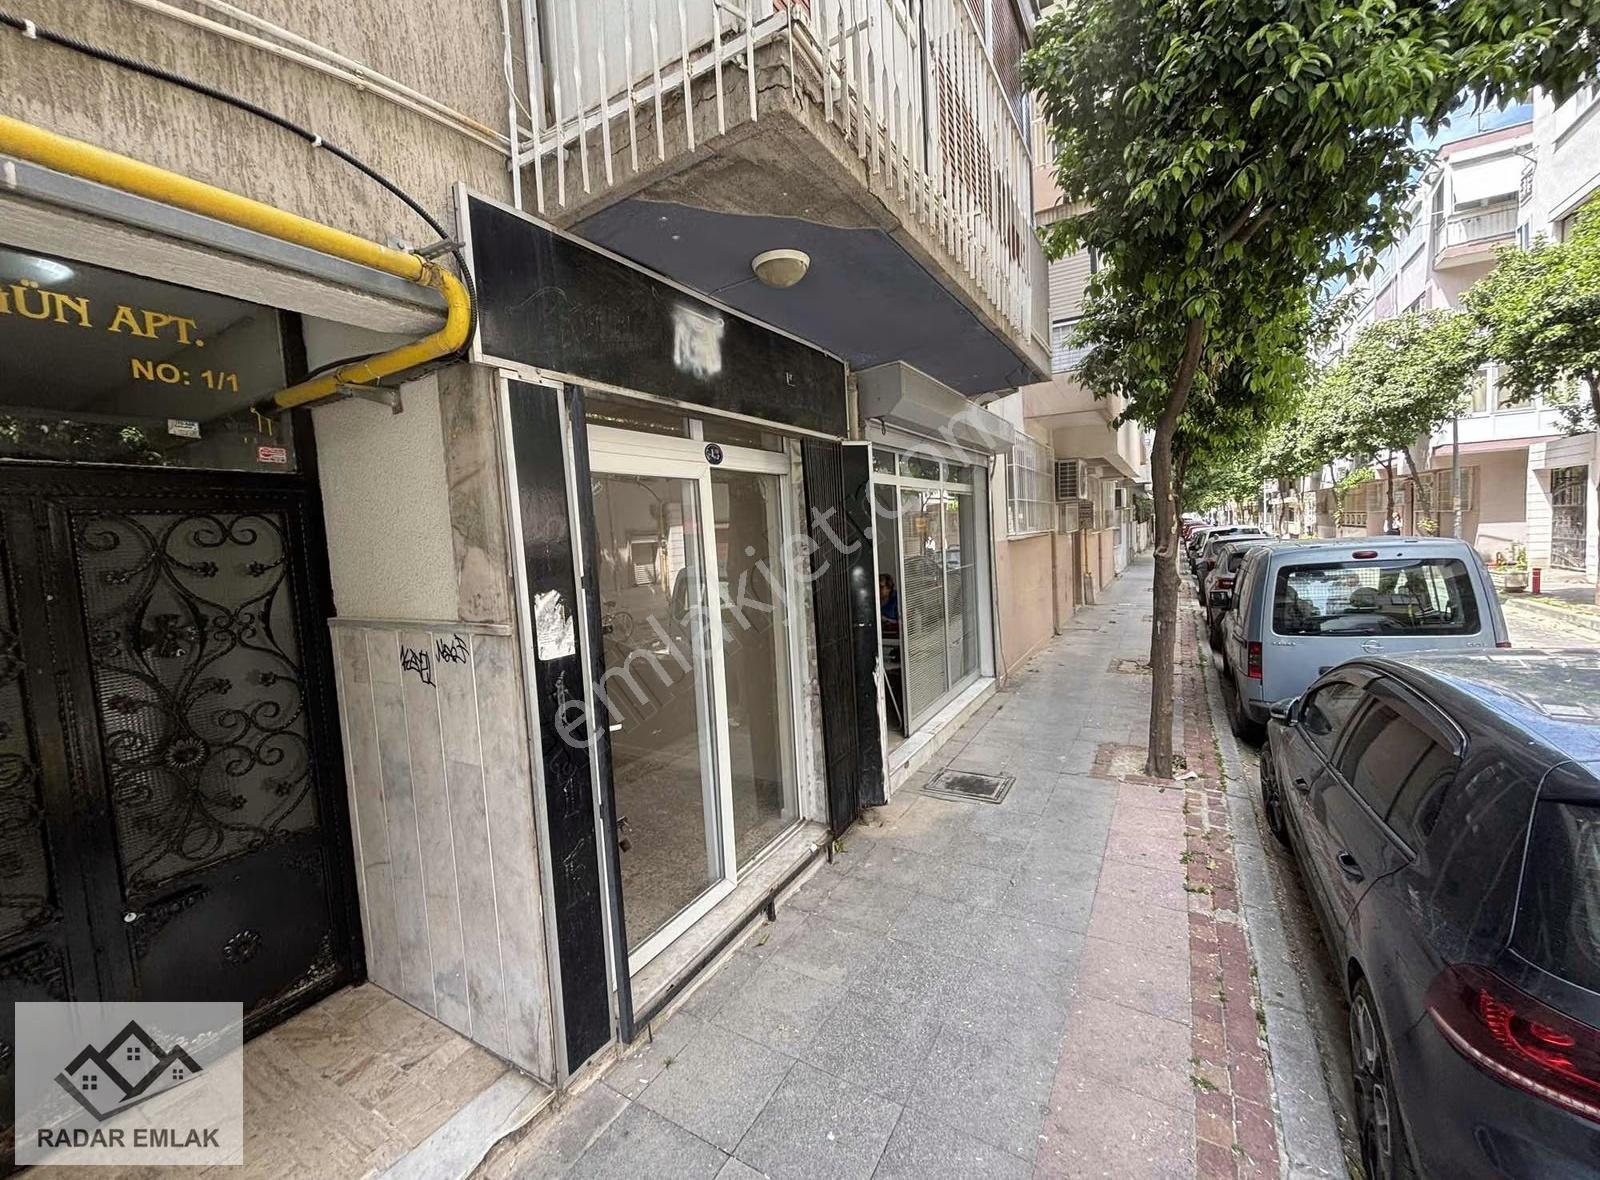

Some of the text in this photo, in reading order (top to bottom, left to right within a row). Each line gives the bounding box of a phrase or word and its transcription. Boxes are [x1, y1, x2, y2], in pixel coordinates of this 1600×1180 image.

[108, 305, 205, 348] APT.
[131, 358, 239, 393] NO: 1/1
